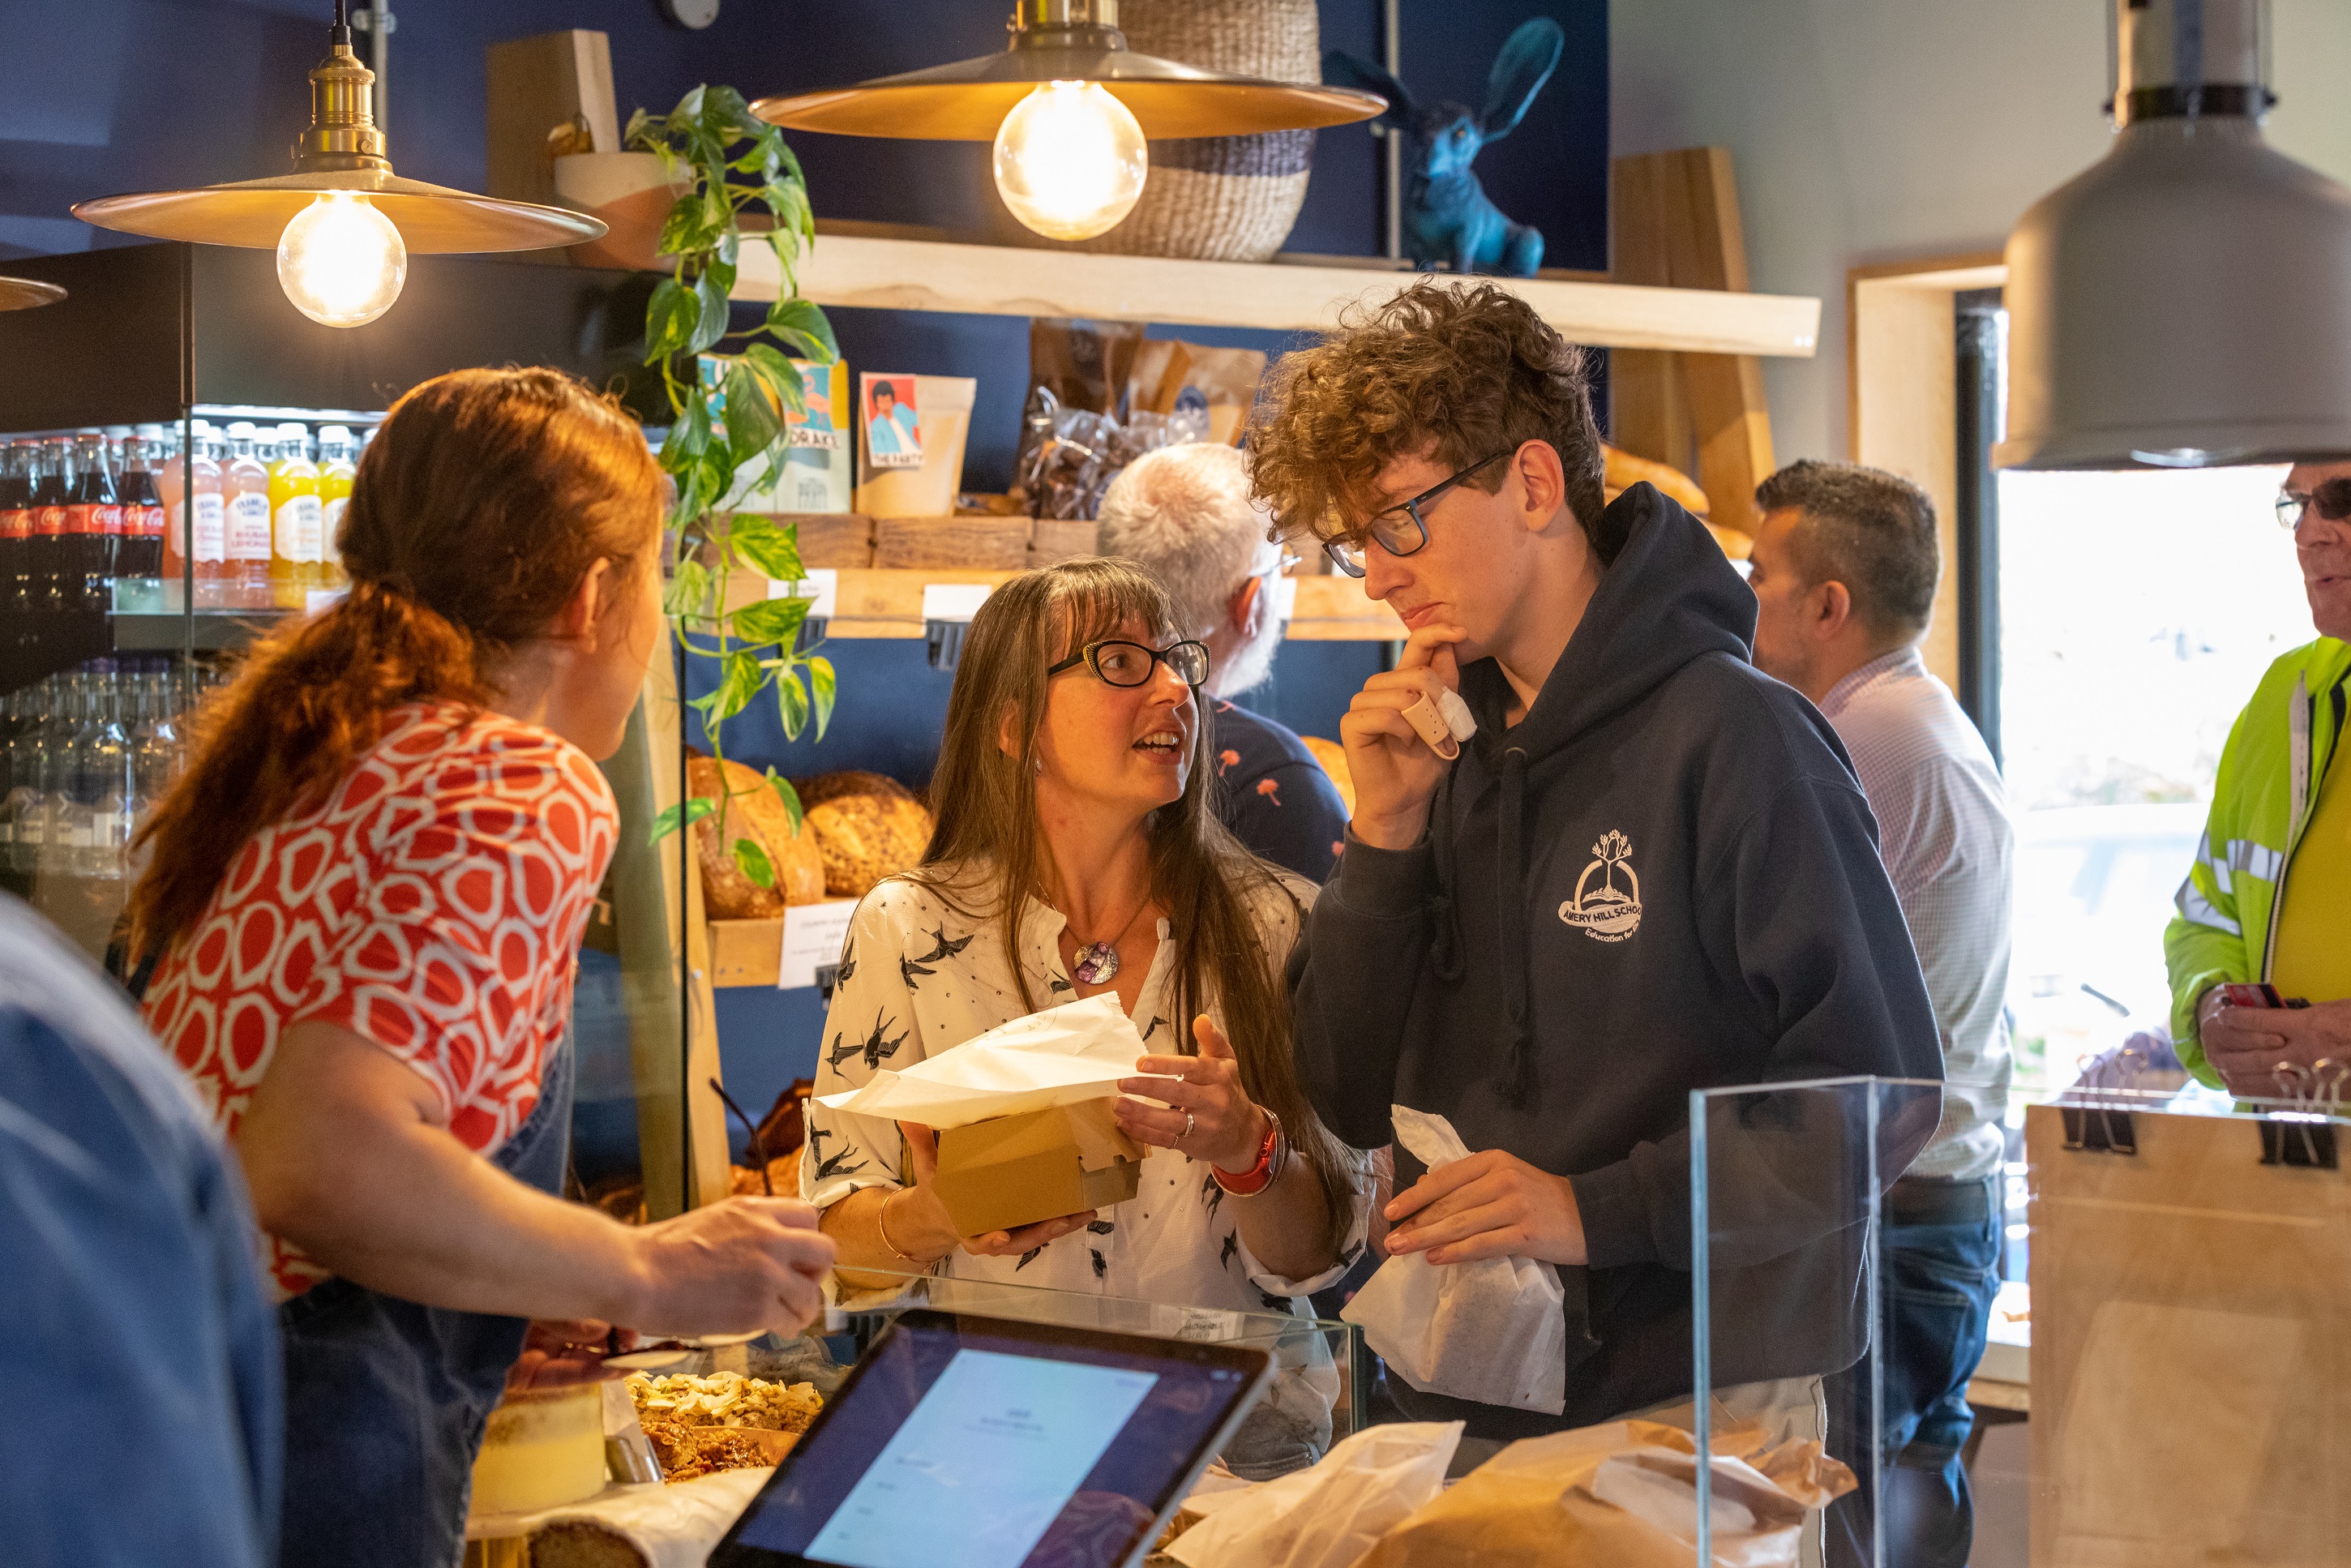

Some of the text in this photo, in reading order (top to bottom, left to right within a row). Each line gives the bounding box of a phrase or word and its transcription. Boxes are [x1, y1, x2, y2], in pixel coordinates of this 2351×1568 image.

[1563, 910, 1591, 923] AMERY
[1593, 910, 1615, 923] HILL
[1585, 928, 1624, 942] Education
